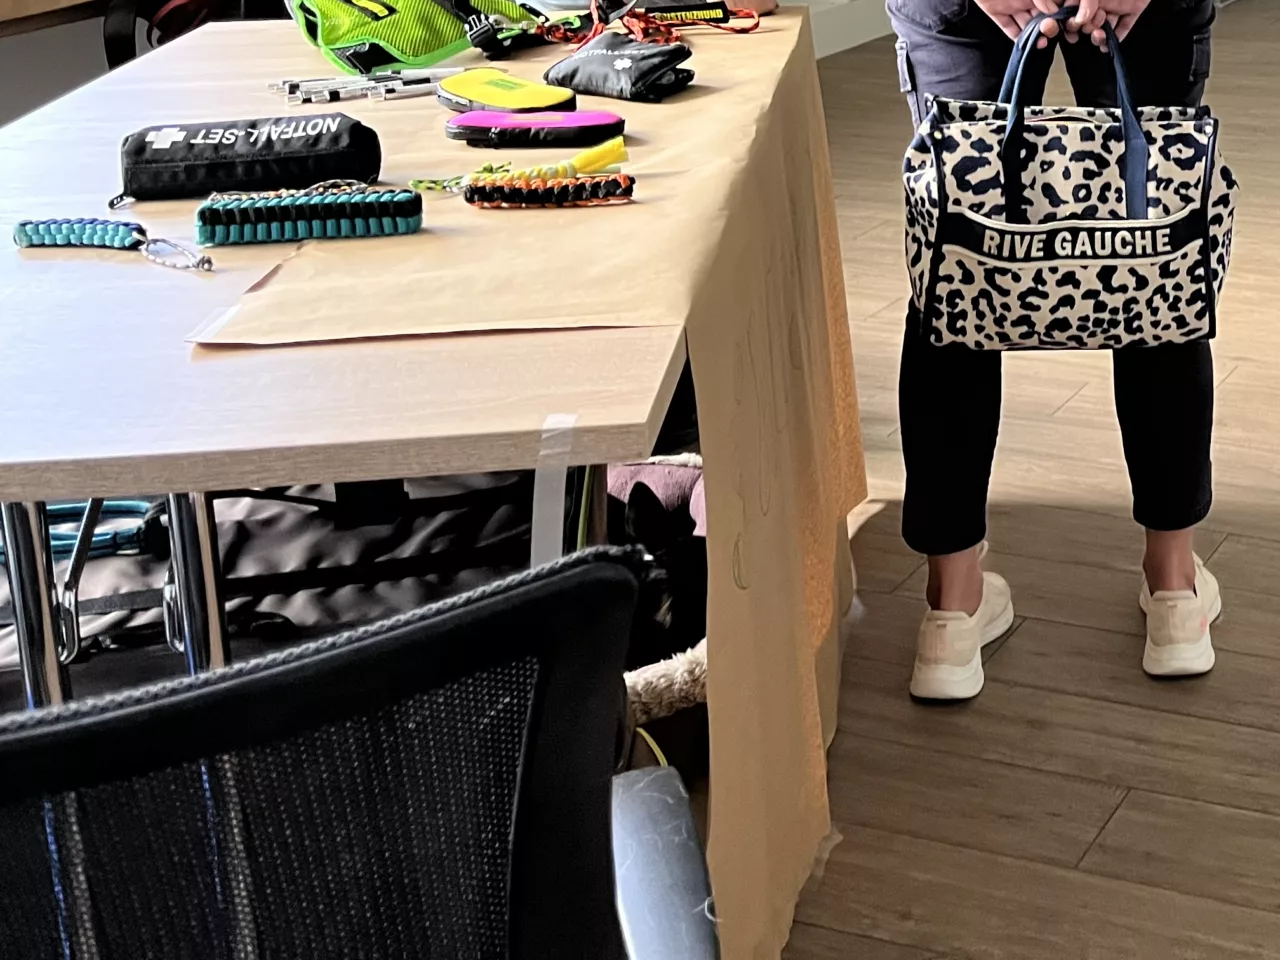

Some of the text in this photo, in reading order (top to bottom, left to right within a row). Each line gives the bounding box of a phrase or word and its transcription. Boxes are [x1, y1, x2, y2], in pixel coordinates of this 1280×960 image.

[190, 117, 342, 145] NOTFALL-SET
[982, 228, 1172, 258] RIVE GAUCHE
